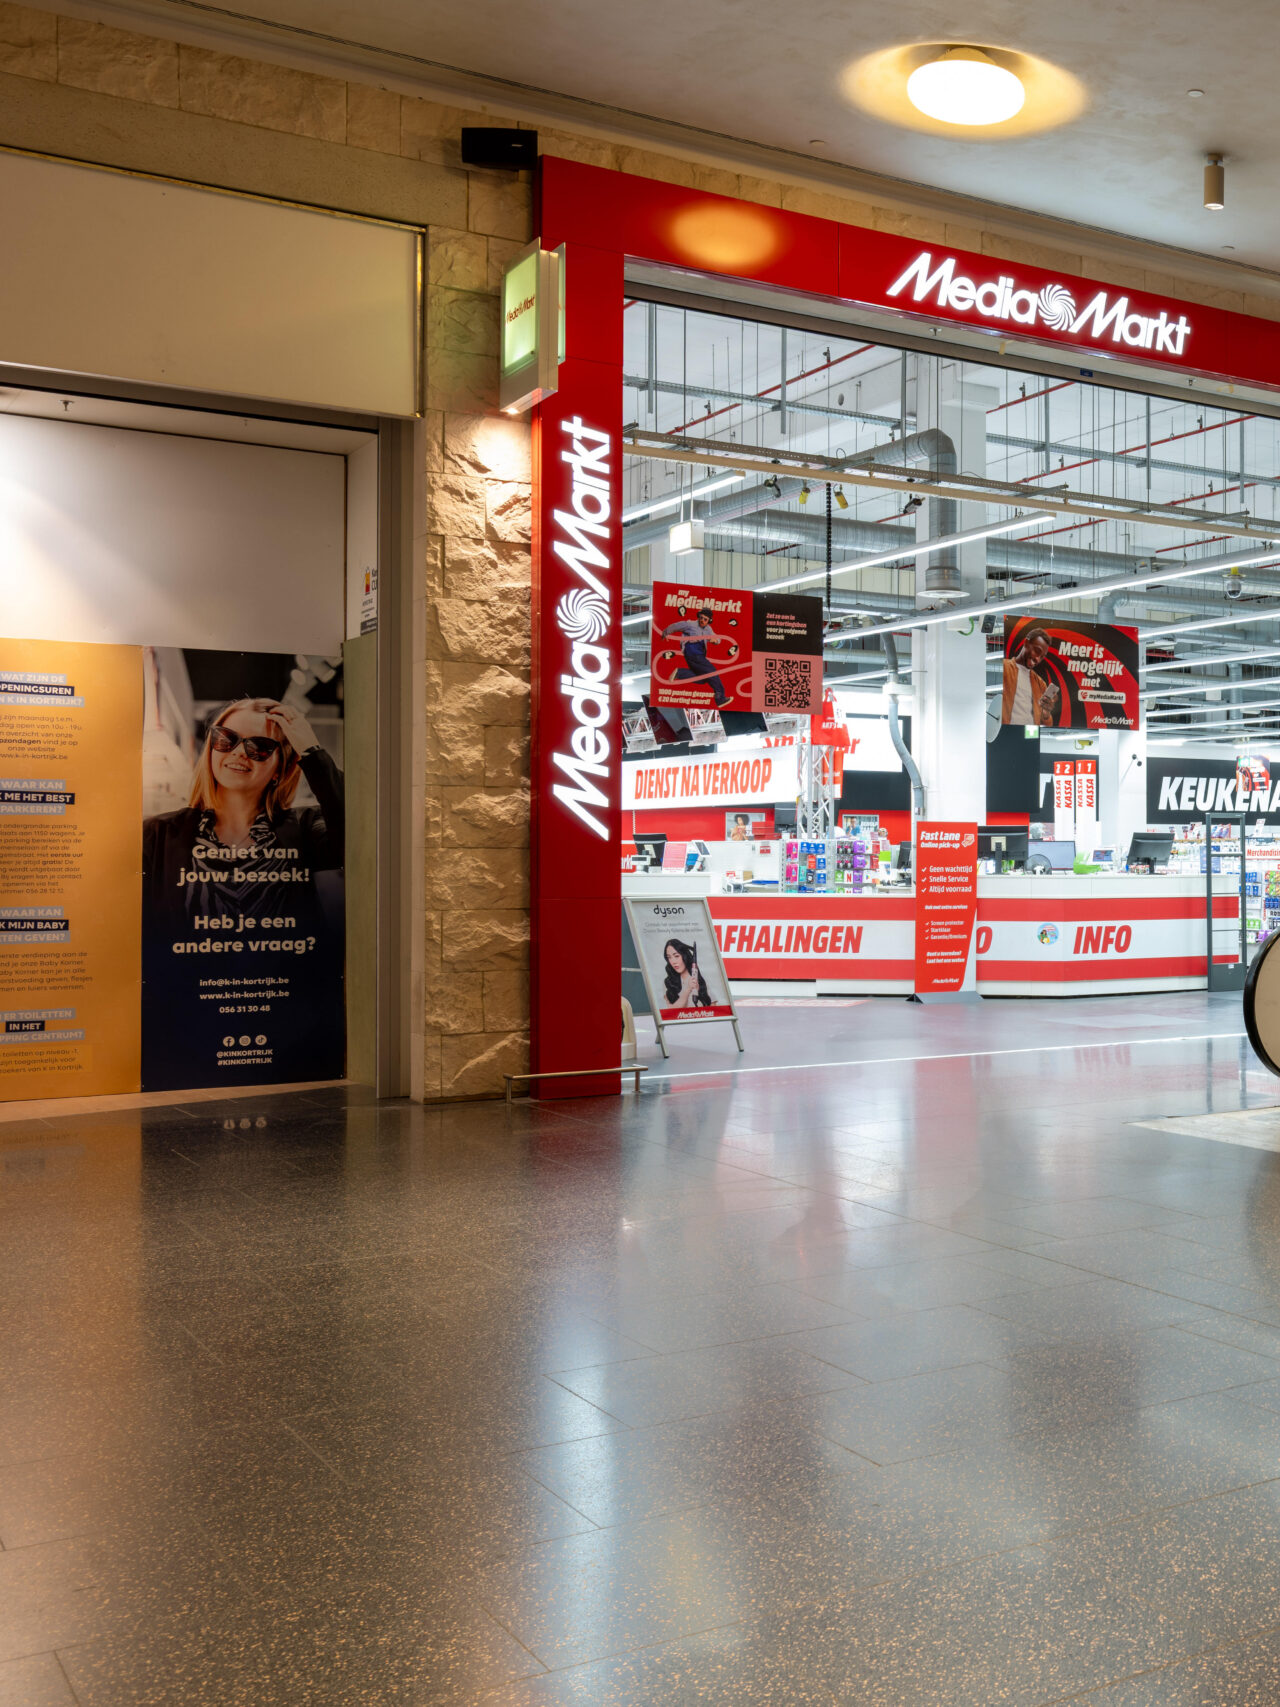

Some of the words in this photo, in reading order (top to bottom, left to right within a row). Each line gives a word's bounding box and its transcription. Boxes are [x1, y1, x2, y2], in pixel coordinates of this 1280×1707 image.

[886, 252, 1039, 325] Media
[1069, 292, 1191, 355] Markt
[553, 415, 610, 602] Markt
[664, 593, 742, 613] MediaMarkt
[1058, 641, 1093, 658] Meer
[1093, 643, 1104, 659] is
[1067, 659, 1125, 678] mogelijk
[1, 672, 24, 681] WAT
[26, 673, 49, 683] ZIJN
[51, 674, 65, 683] DE
[1081, 677, 1100, 688] met
[0, 683, 72, 695] PENINGSUREN
[8, 696, 15, 704] K
[17, 696, 27, 704] IN
[552, 640, 610, 841] Media
[1, 781, 37, 789] WAAR
[39, 781, 63, 789] KAN
[634, 767, 679, 800] DIENST
[680, 764, 699, 797] NA
[702, 758, 772, 796] VERKOOP
[5, 793, 20, 801] ME
[23, 793, 43, 802] HET
[46, 794, 71, 802] BEST
[1064, 780, 1072, 808] KASSA
[1086, 779, 1094, 808] KASSA
[0, 805, 62, 813] PARKEREN?
[920, 831, 939, 840] Fast
[939, 831, 960, 841] Lane
[191, 844, 258, 859] Geniet
[263, 847, 299, 859] van
[176, 868, 229, 887] jouw
[233, 867, 310, 882] bezoek!
[1, 909, 36, 917] WAAR
[653, 904, 685, 918] dyson
[194, 914, 234, 930] Heb
[235, 914, 256, 933] je
[260, 917, 296, 929] een
[0, 934, 22, 942] TEN
[24, 933, 65, 942] GEVEN?
[1073, 924, 1132, 954] INFO
[172, 938, 244, 954] andere
[248, 936, 316, 955] vraag?
[199, 977, 289, 987] info@k-in-kortrijk.be
[199, 990, 290, 1000] www.k-in-kortrijk.be
[18, 1010, 72, 1019] TOILETTEN
[0, 1034, 29, 1042] PPING
[216, 1049, 273, 1058] @KINKORTRIJK
[217, 1057, 273, 1066] #KINKORTRIJK
